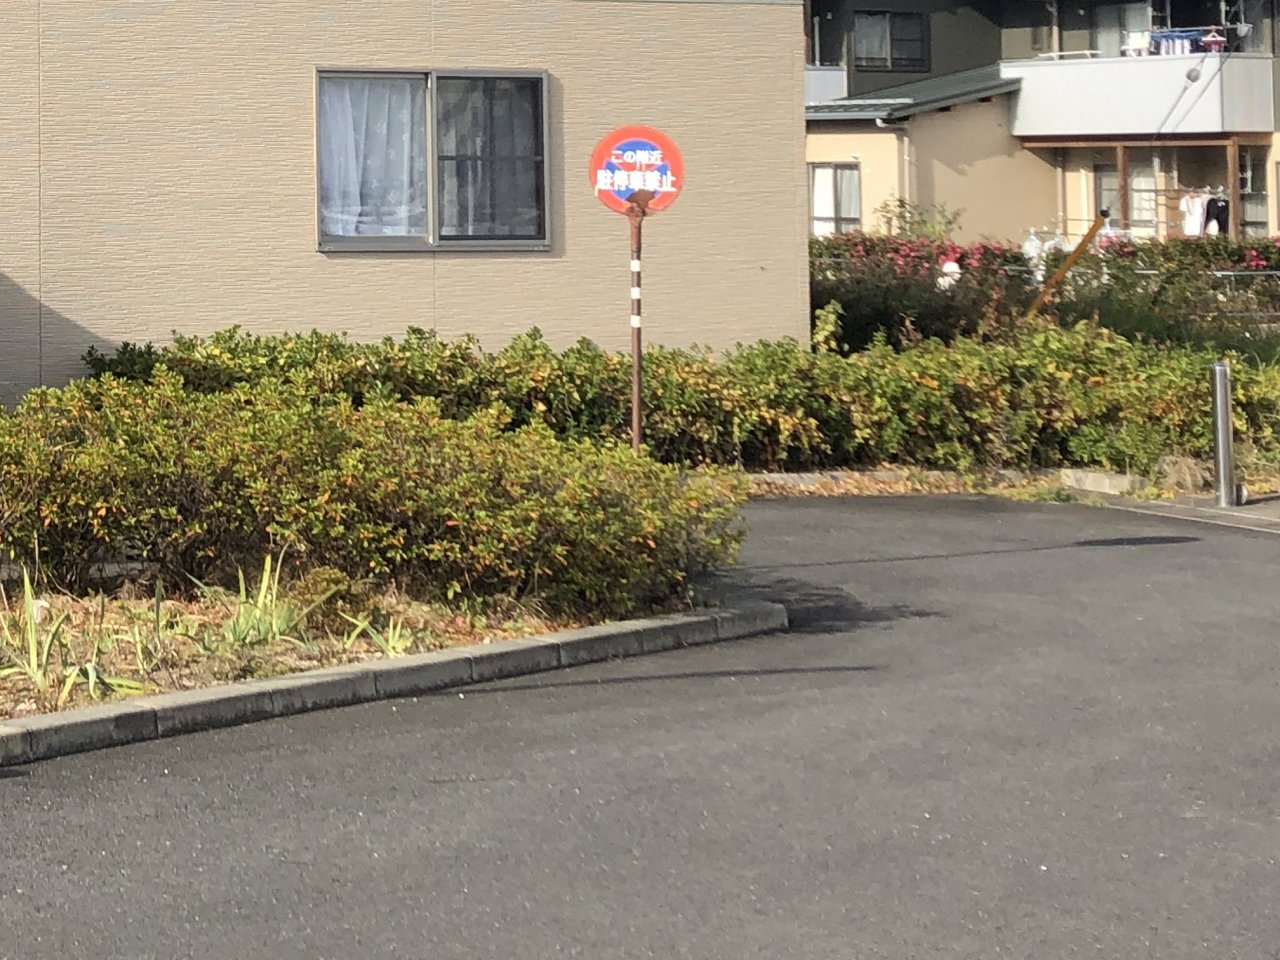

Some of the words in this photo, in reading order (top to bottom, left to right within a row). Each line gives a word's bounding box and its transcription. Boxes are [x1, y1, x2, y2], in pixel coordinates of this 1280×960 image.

[596, 169, 677, 192] 駐停車禁止
